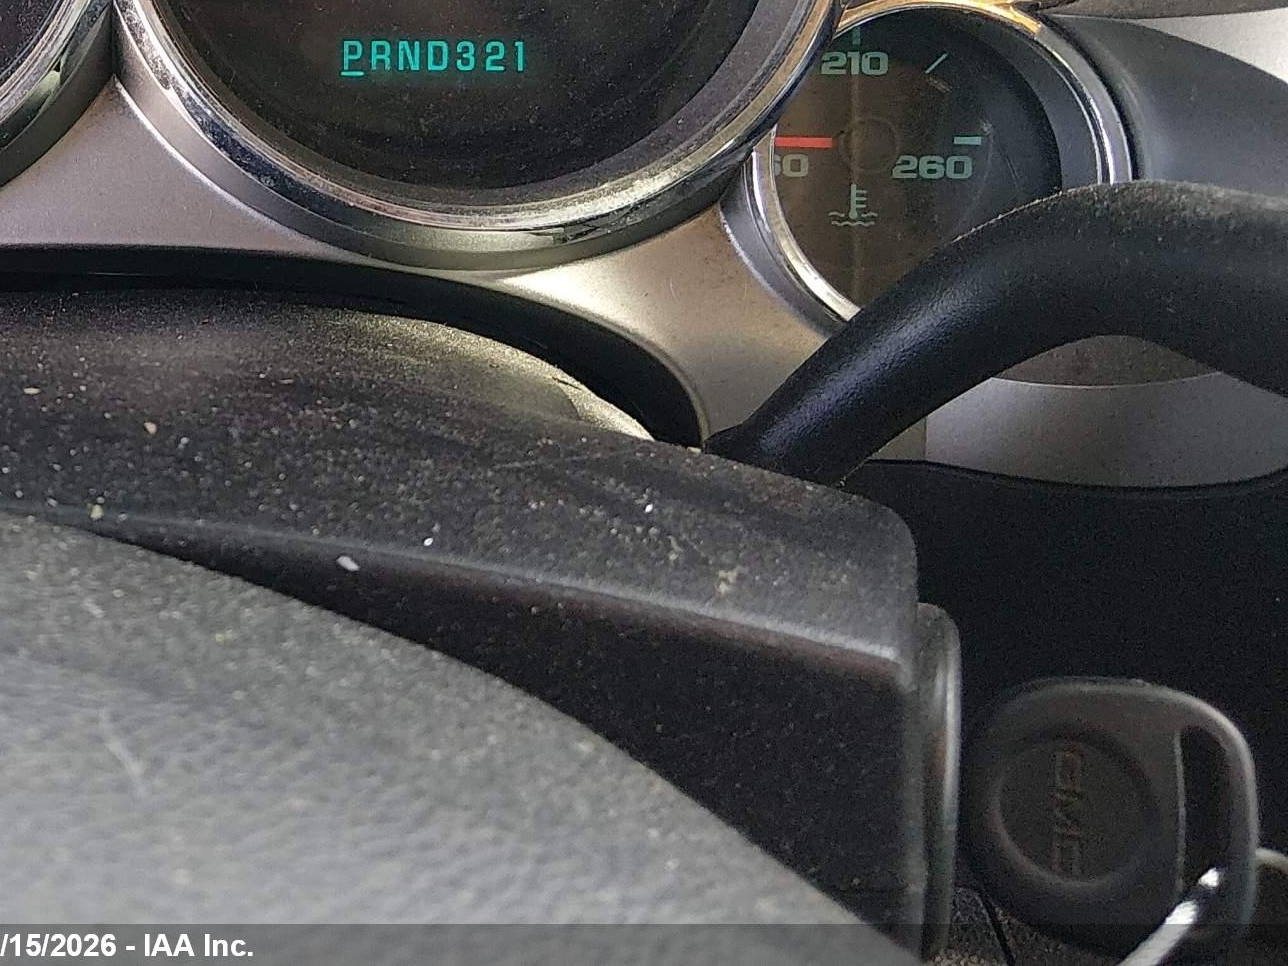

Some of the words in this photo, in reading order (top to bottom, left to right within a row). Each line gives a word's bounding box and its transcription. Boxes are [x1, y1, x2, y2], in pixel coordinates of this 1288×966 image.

[341, 40, 524, 74] PRND321
[821, 52, 889, 76] 210
[892, 156, 973, 180] 260
